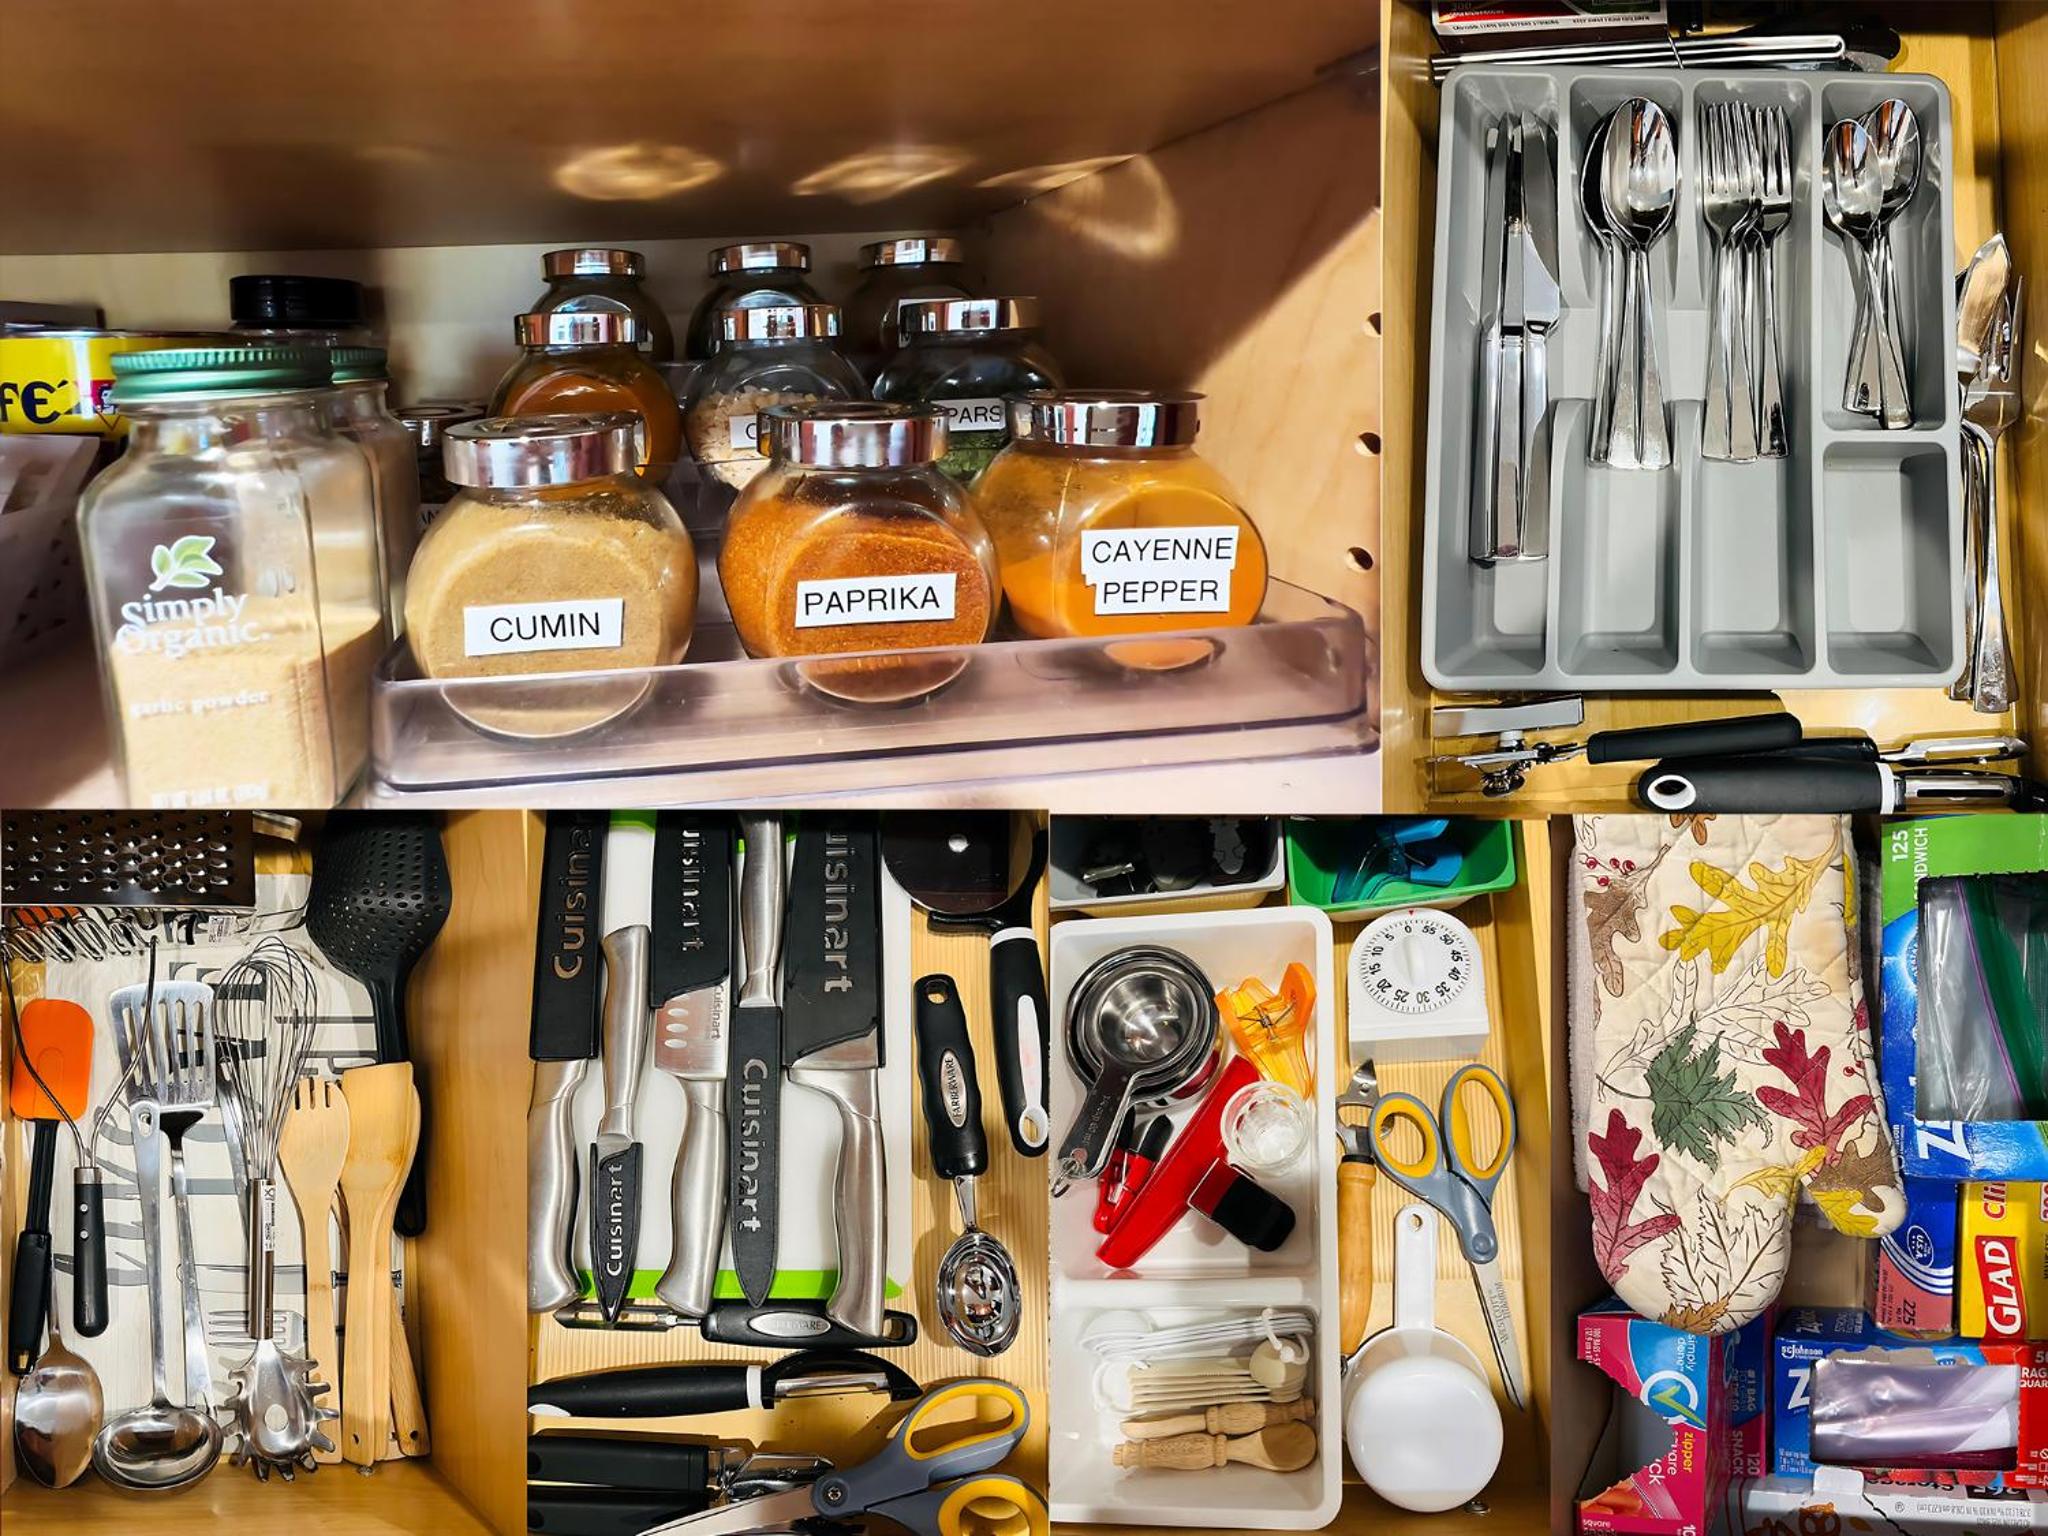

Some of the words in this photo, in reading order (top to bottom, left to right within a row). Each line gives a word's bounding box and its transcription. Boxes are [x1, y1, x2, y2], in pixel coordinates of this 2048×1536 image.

[1092, 537, 1233, 564] CAYENNE
[804, 585, 941, 616] PAPRIKA
[1103, 579, 1219, 604] PEPPER
[121, 587, 248, 631] Simply
[489, 612, 600, 643] CUMIN
[191, 691, 270, 714] powder
[1891, 830, 1909, 862] 125
[1384, 933, 1395, 942] 5
[1404, 925, 1412, 934] 0
[1422, 925, 1438, 935] 55
[1439, 933, 1455, 946] 50
[1371, 945, 1384, 957] 10
[1450, 949, 1464, 962] 45
[1368, 962, 1382, 976] 15
[1448, 966, 1462, 981] 40
[1376, 978, 1393, 994] 20
[1393, 989, 1410, 1003] 25
[1416, 990, 1431, 1004] 30
[1434, 981, 1451, 998] 35
[944, 1057, 962, 1118] FARBERWARE
[743, 1058, 768, 1233] Cuisinart
[606, 1164, 624, 1278] Cuisinart
[1984, 1240, 2022, 1335] GLAD
[1902, 1298, 1916, 1326] 225
[1685, 1334, 1697, 1371] simply
[1678, 1431, 1695, 1474] zipper
[1732, 1429, 1744, 1476] SNACK
[1746, 1451, 1761, 1476] 120
